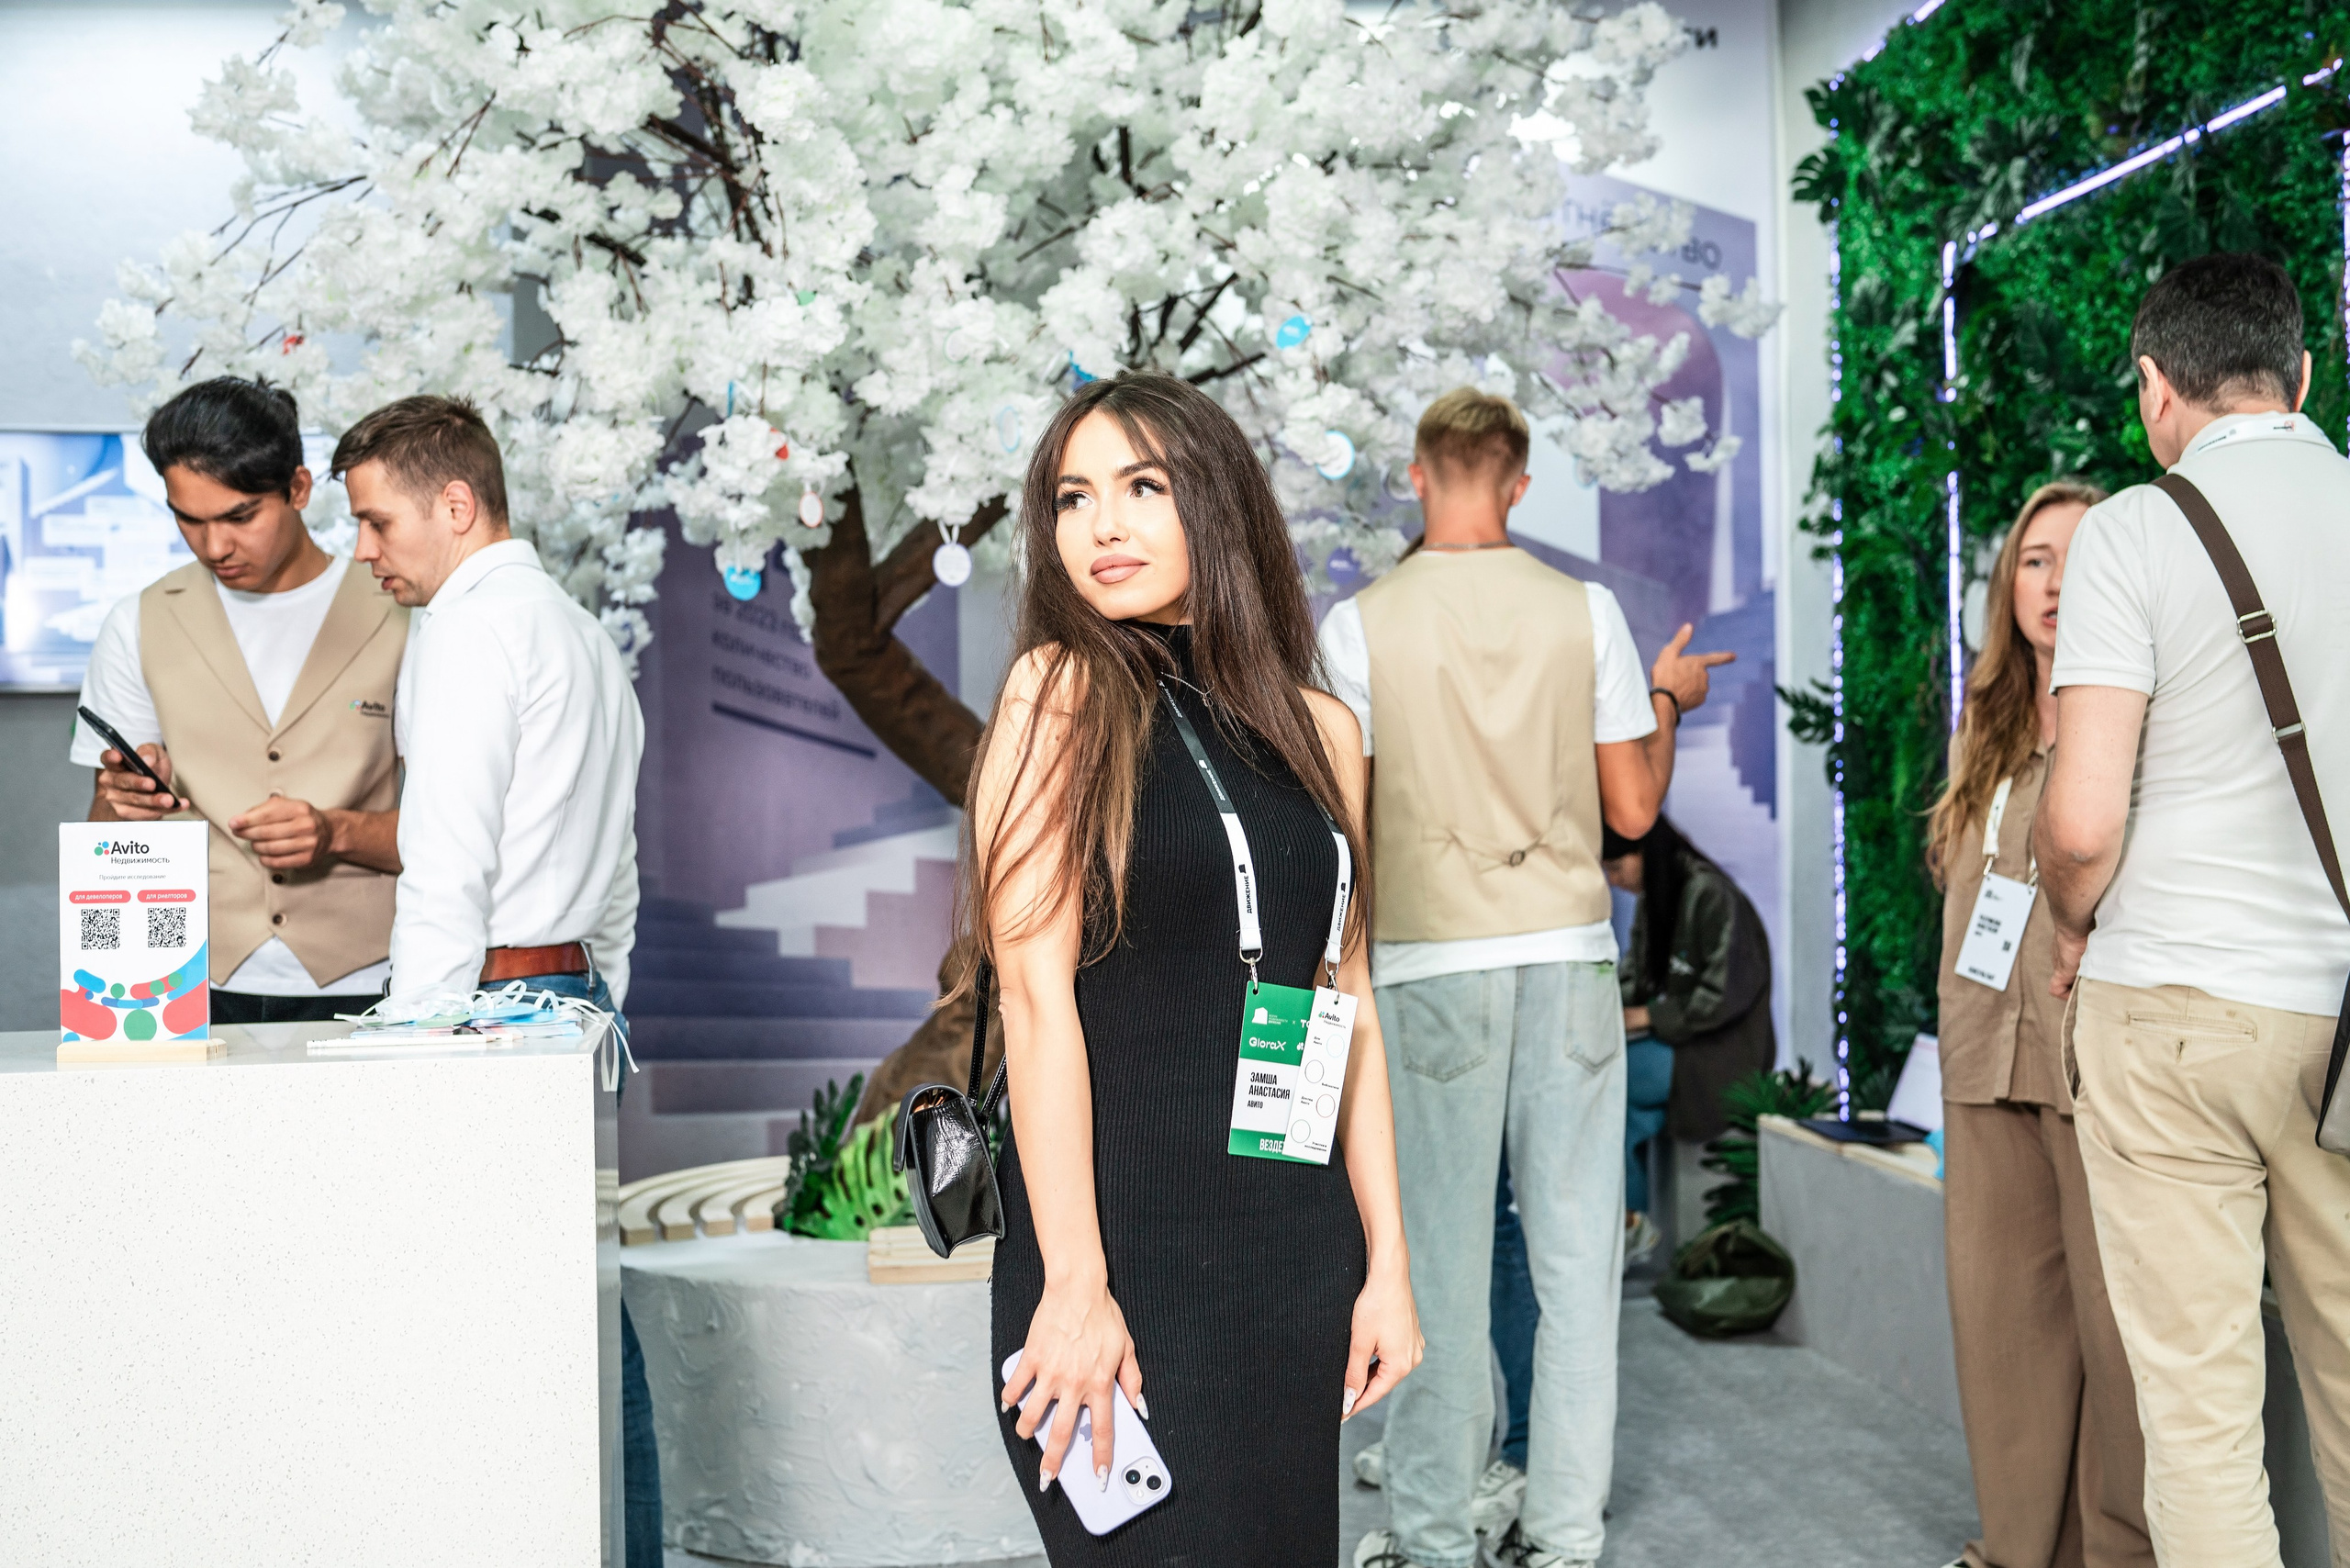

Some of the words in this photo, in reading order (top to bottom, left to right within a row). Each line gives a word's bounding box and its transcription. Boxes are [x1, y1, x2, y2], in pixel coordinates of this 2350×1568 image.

[110, 840, 150, 855] Avito
[110, 857, 171, 865] Недвижимость
[1244, 875, 1253, 914] ДВИЖЕНИЕ
[1337, 893, 1347, 932] ДВИЖЕНИЕ
[1324, 1012, 1340, 1023] Avito
[1248, 1036, 1287, 1051] GloraX
[1250, 1071, 1278, 1085] ЗАМША
[1248, 1084, 1291, 1100] АНАСТАСИЯ
[1247, 1100, 1264, 1109] АВИТО
[1259, 1137, 1284, 1153] ВЕЗДЕ
